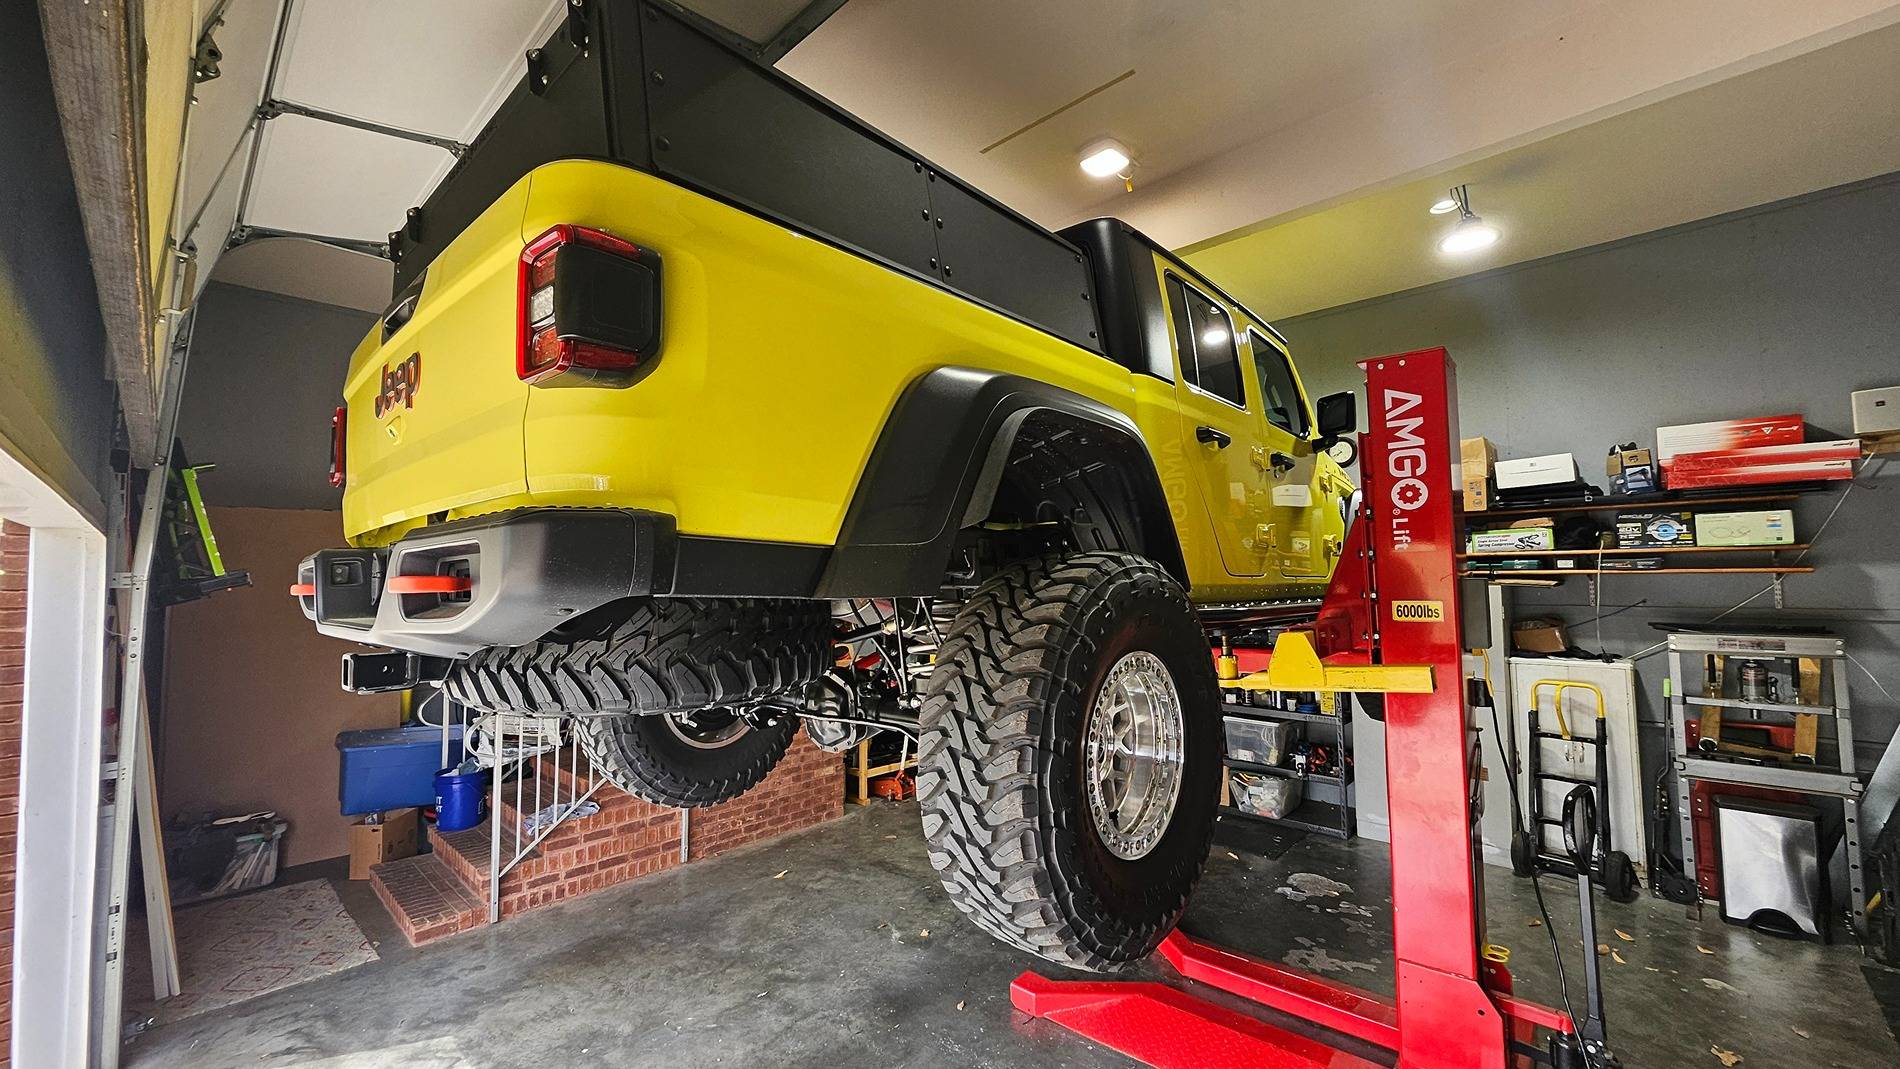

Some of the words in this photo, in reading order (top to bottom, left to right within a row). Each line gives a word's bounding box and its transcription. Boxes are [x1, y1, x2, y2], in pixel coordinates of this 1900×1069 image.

[375, 352, 421, 419] Jeep
[1384, 388, 1428, 510] AMGO
[1392, 517, 1411, 551] Lift
[1396, 604, 1440, 618] 6000lbs
